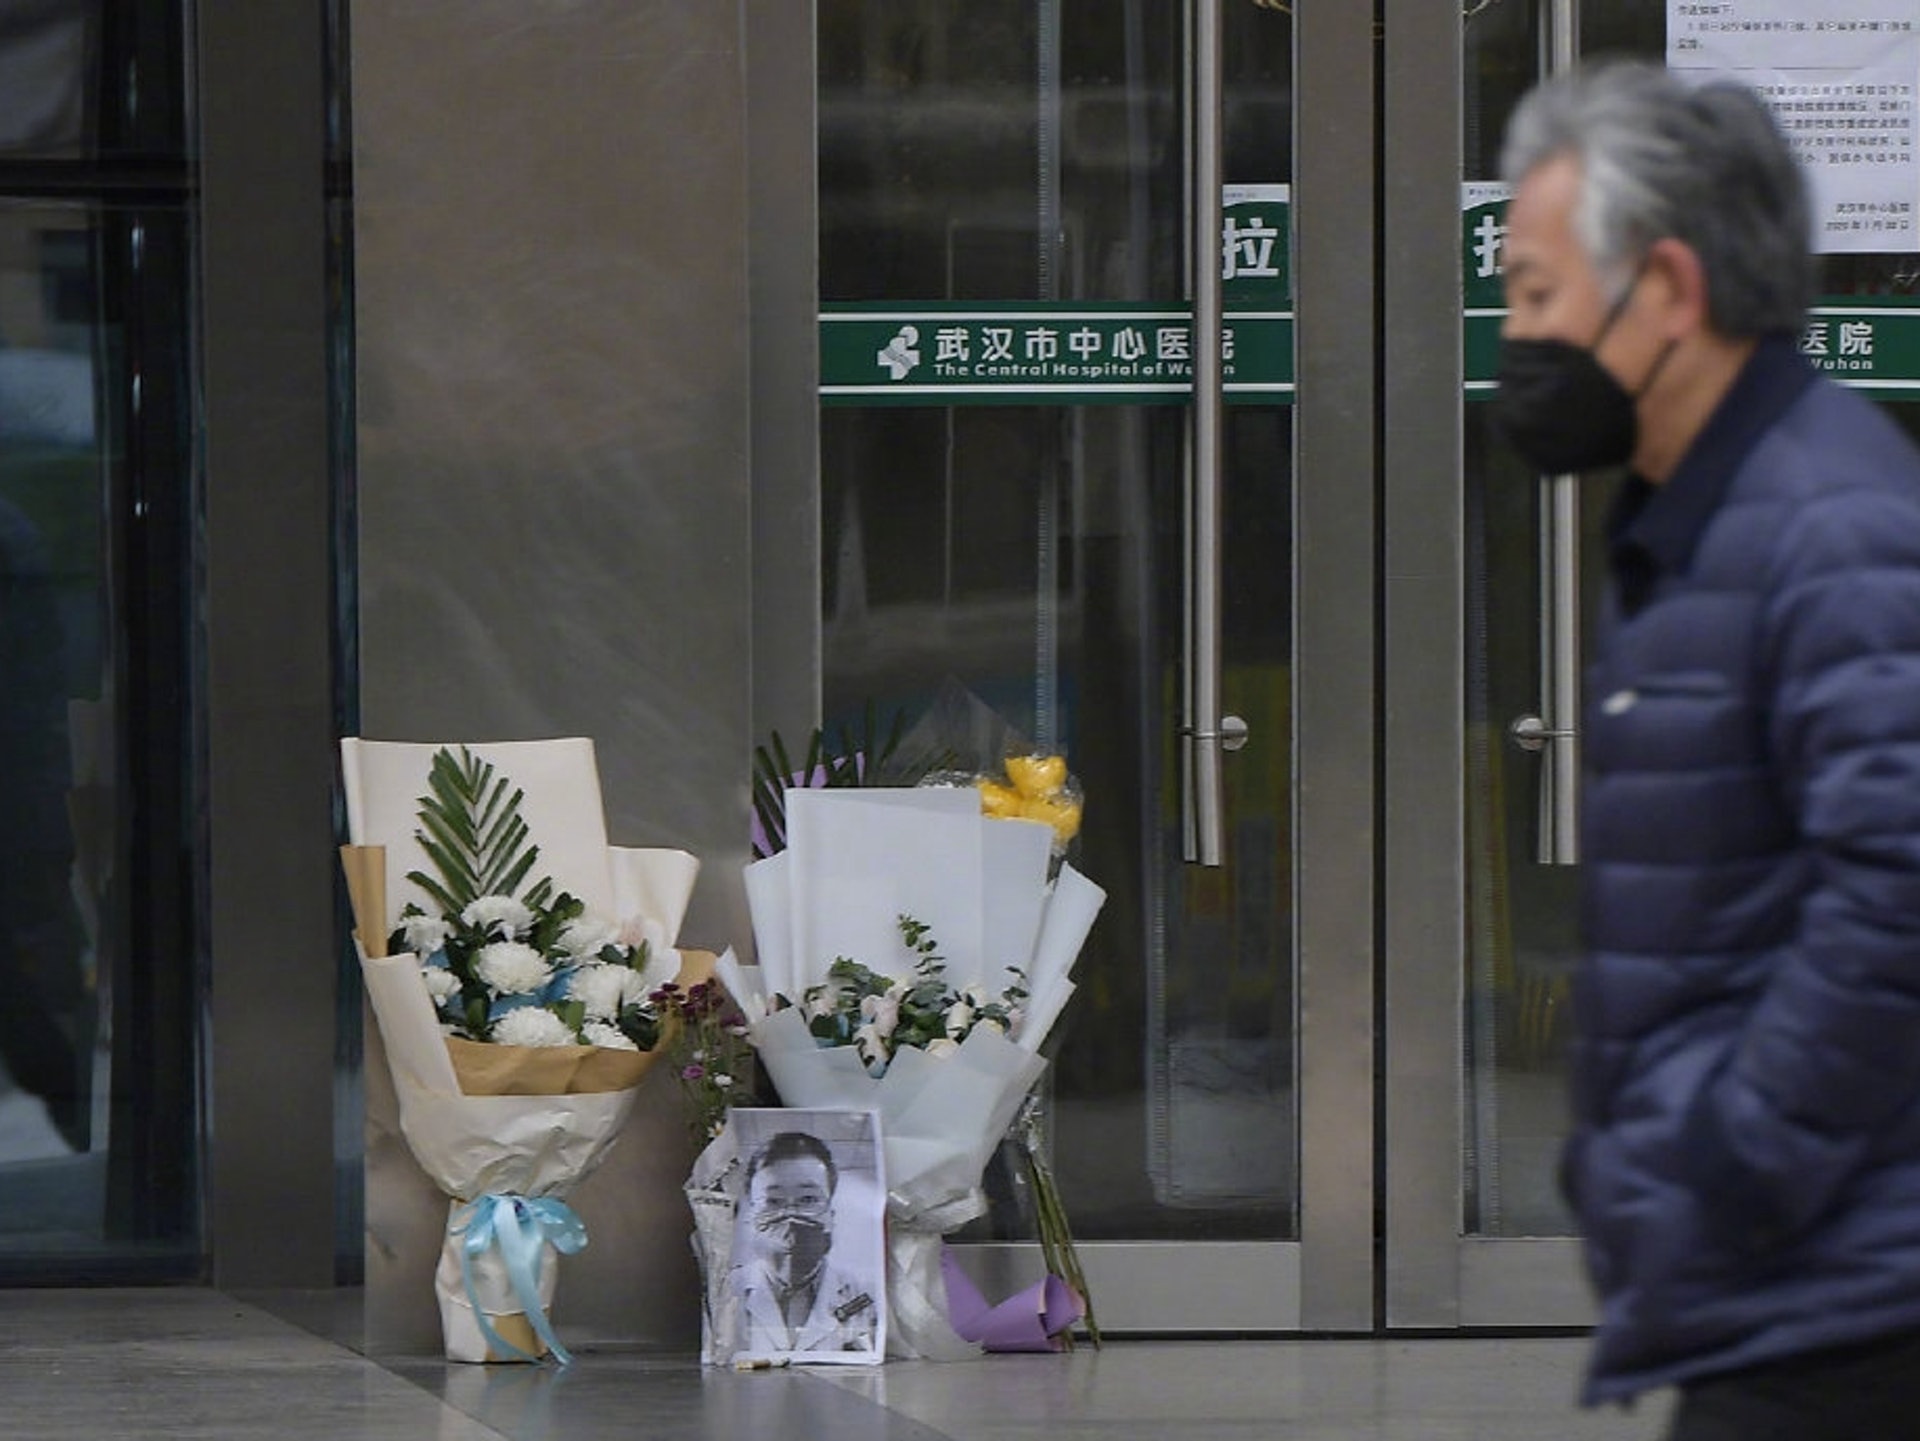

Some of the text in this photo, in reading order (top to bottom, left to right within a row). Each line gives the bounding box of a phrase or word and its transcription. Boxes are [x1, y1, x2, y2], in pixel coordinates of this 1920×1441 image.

[1222, 216, 1279, 280] 拉
[933, 362, 969, 376] The
[974, 362, 1048, 376] Central
[1053, 362, 1139, 378] Hospital
[1142, 362, 1163, 376] of
